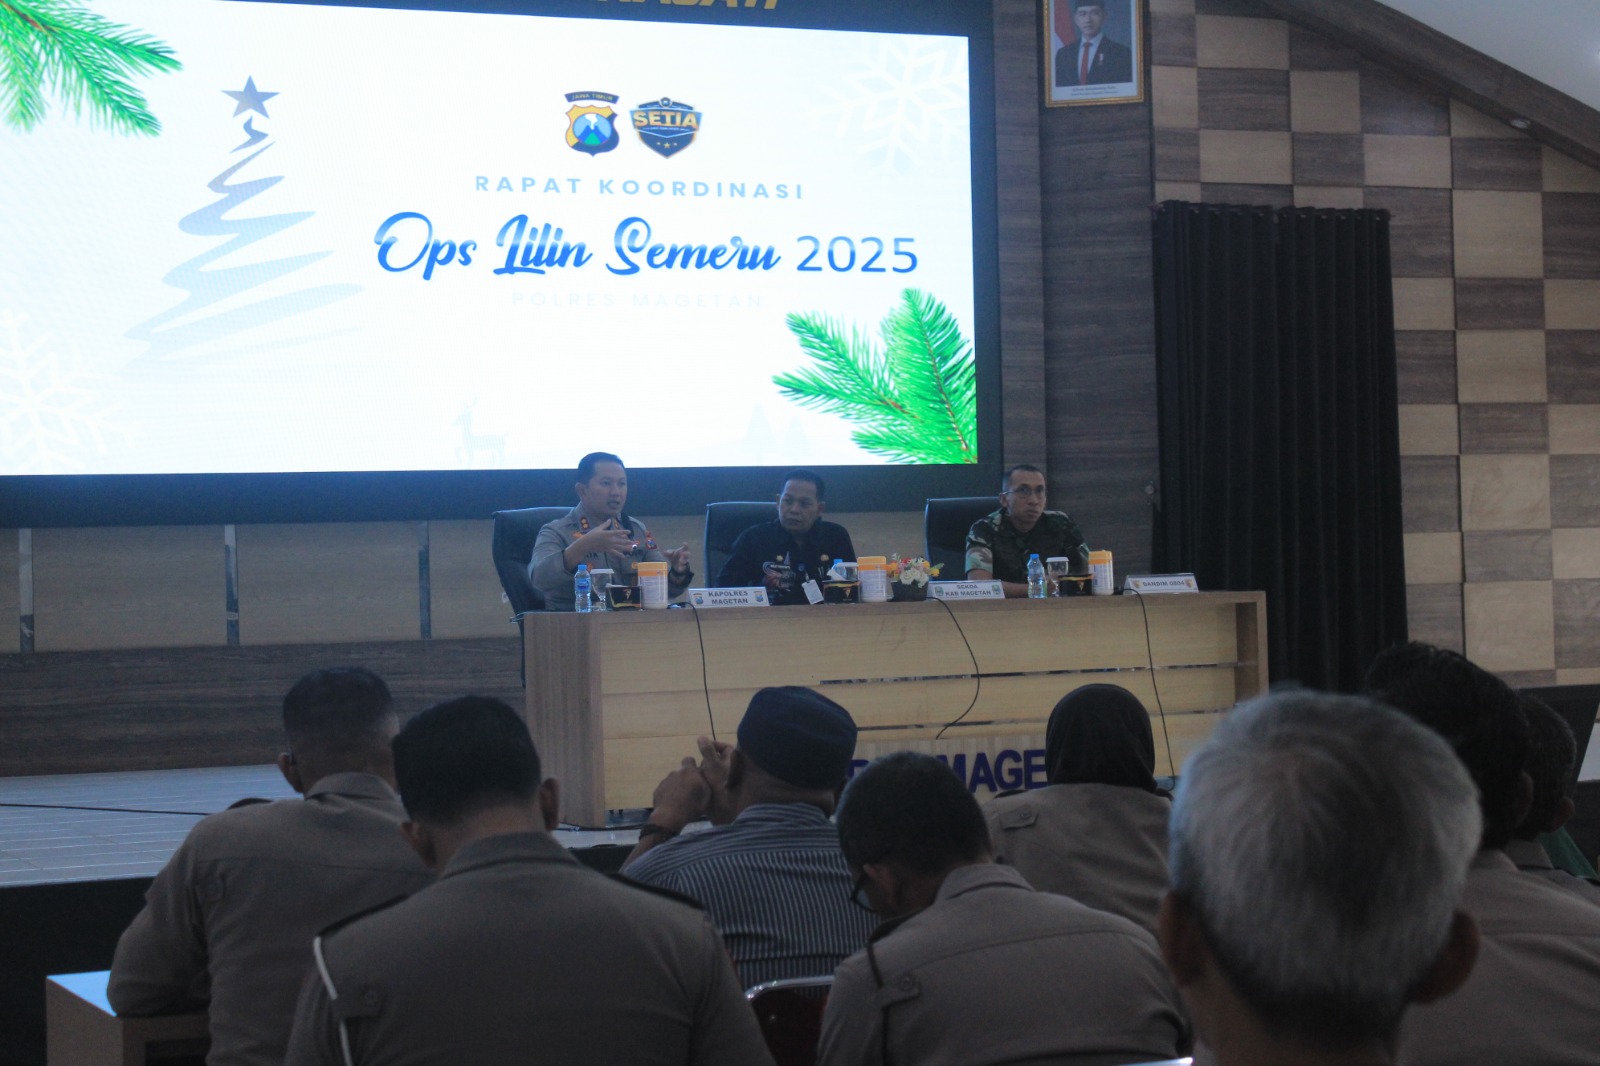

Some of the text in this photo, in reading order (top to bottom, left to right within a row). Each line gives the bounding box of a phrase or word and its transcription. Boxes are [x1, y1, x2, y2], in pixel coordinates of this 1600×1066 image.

[633, 111, 699, 129] SETIA
[475, 176, 803, 199] RAPAT KOORDINASI
[373, 211, 918, 281] Ops Lilin Semeru 2025
[512, 292, 762, 308] POLRES MAGETAN
